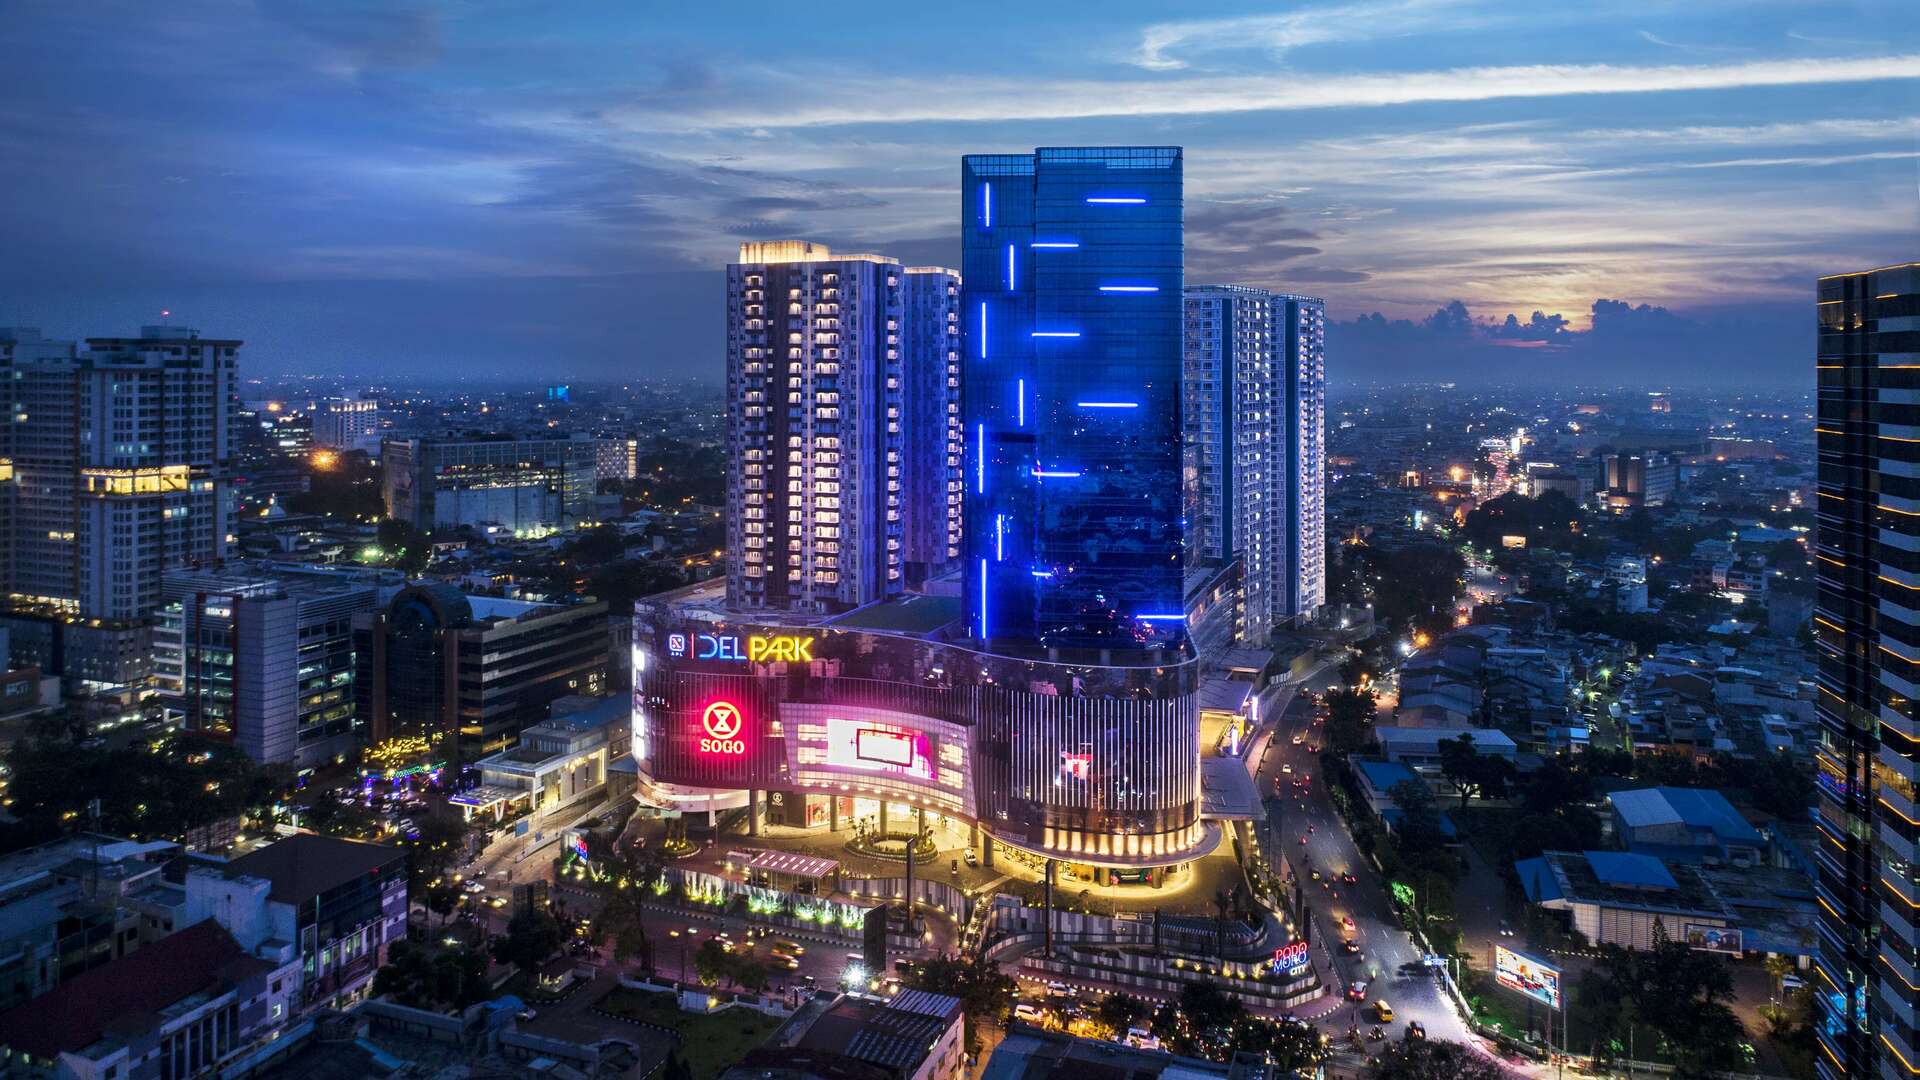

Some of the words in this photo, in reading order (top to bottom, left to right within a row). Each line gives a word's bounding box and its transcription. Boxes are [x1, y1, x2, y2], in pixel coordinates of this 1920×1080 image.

[700, 739, 745, 754] SOGO
[1275, 942, 1307, 962] PODO
[1273, 952, 1307, 973] MORO
[1290, 964, 1306, 976] CITY
